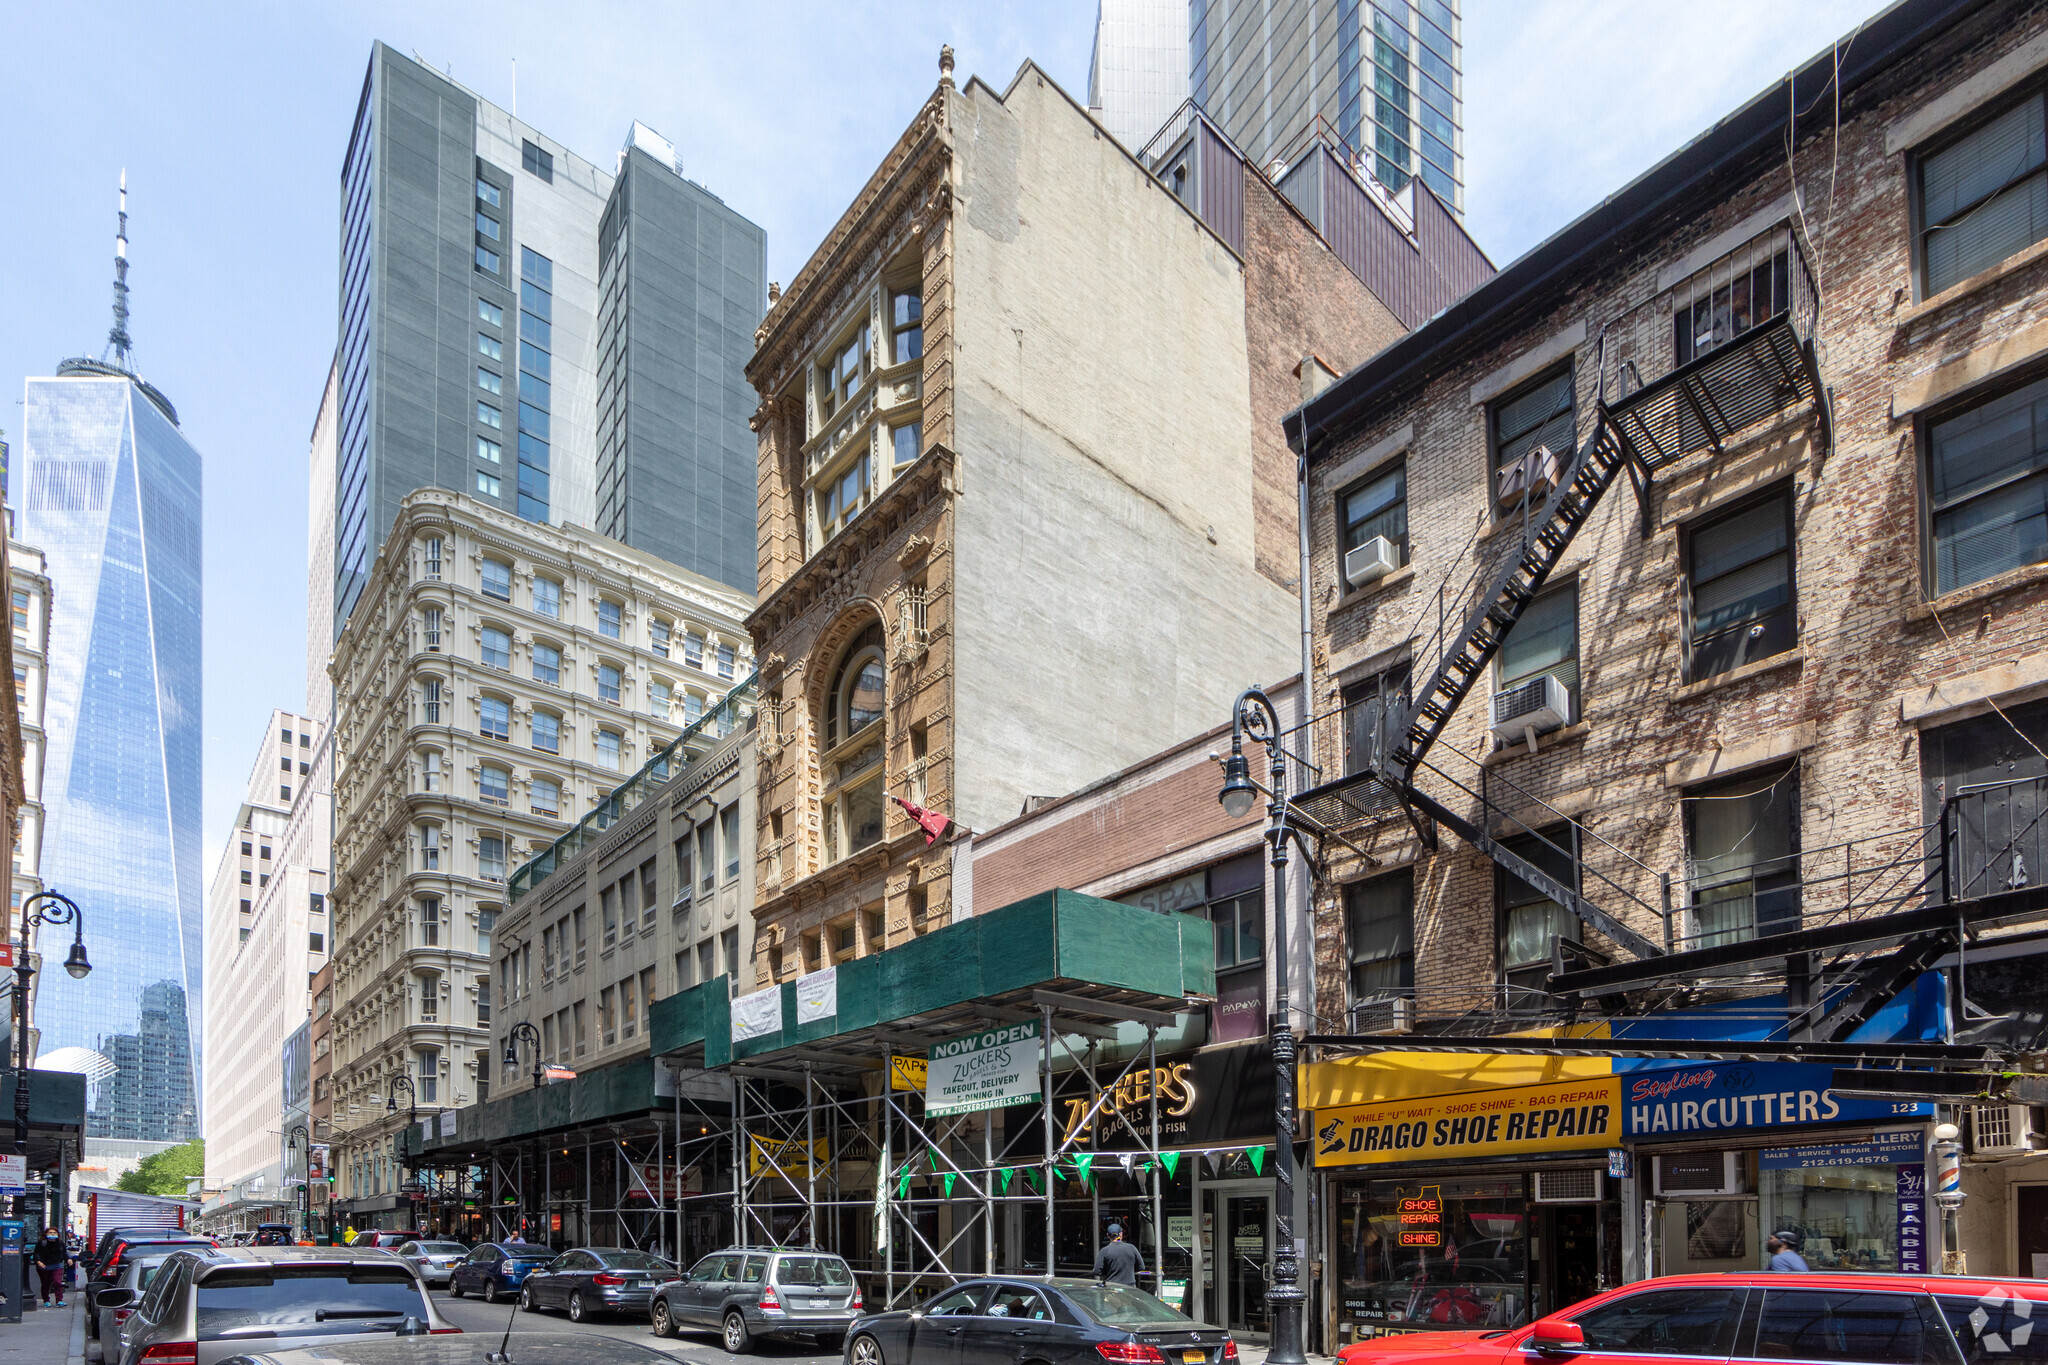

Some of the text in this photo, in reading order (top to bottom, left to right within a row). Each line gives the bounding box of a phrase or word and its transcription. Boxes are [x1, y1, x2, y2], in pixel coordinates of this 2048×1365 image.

[1140, 880, 1199, 917] SPA
[1222, 999, 1261, 1013] PAPYA
[935, 1023, 1034, 1059] NOW OPEN
[952, 1046, 1012, 1083] ZUCKER'S
[969, 1065, 989, 1081] BAGELS
[942, 1082, 979, 1095] TAKEOUT,
[981, 1073, 1020, 1088] DELIVERY
[1631, 1069, 1717, 1101] Styling
[965, 1090, 993, 1102] DINING
[995, 1088, 1004, 1097] IN
[931, 1094, 1032, 1116] WWW.ZUCKERSBAGELS.COM
[1353, 1112, 1385, 1124] WHILE
[1407, 1107, 1434, 1118] WAIT
[1445, 1102, 1478, 1115] SHOE
[1480, 1098, 1516, 1111] SHINE
[1528, 1094, 1557, 1106] BAG
[1559, 1089, 1609, 1103] REPAIR
[1631, 1089, 1840, 1134] HAIRCUTTERS
[1891, 1102, 1918, 1114] 123
[1127, 1121, 1186, 1137] SMOKD FISH
[1348, 1104, 1611, 1153] DRAGO SHOE REPAIR
[1851, 1132, 1920, 1146] LLERY
[1797, 1149, 1832, 1157] SERVICE
[1840, 1147, 1870, 1155] REPAIR
[1879, 1143, 1920, 1152] RESTORE
[1233, 1161, 1249, 1170] 125
[1801, 1155, 1889, 1167] 212.619.4576
[1404, 1200, 1437, 1210] SHOE
[1401, 1213, 1440, 1224] REPAIR
[8, 1228, 18, 1238] P
[1403, 1234, 1436, 1243] SHINE
[1900, 1203, 1921, 1271] BARBER
[1345, 1300, 1365, 1308] SHOE
[1355, 1310, 1383, 1318] REPAIR
